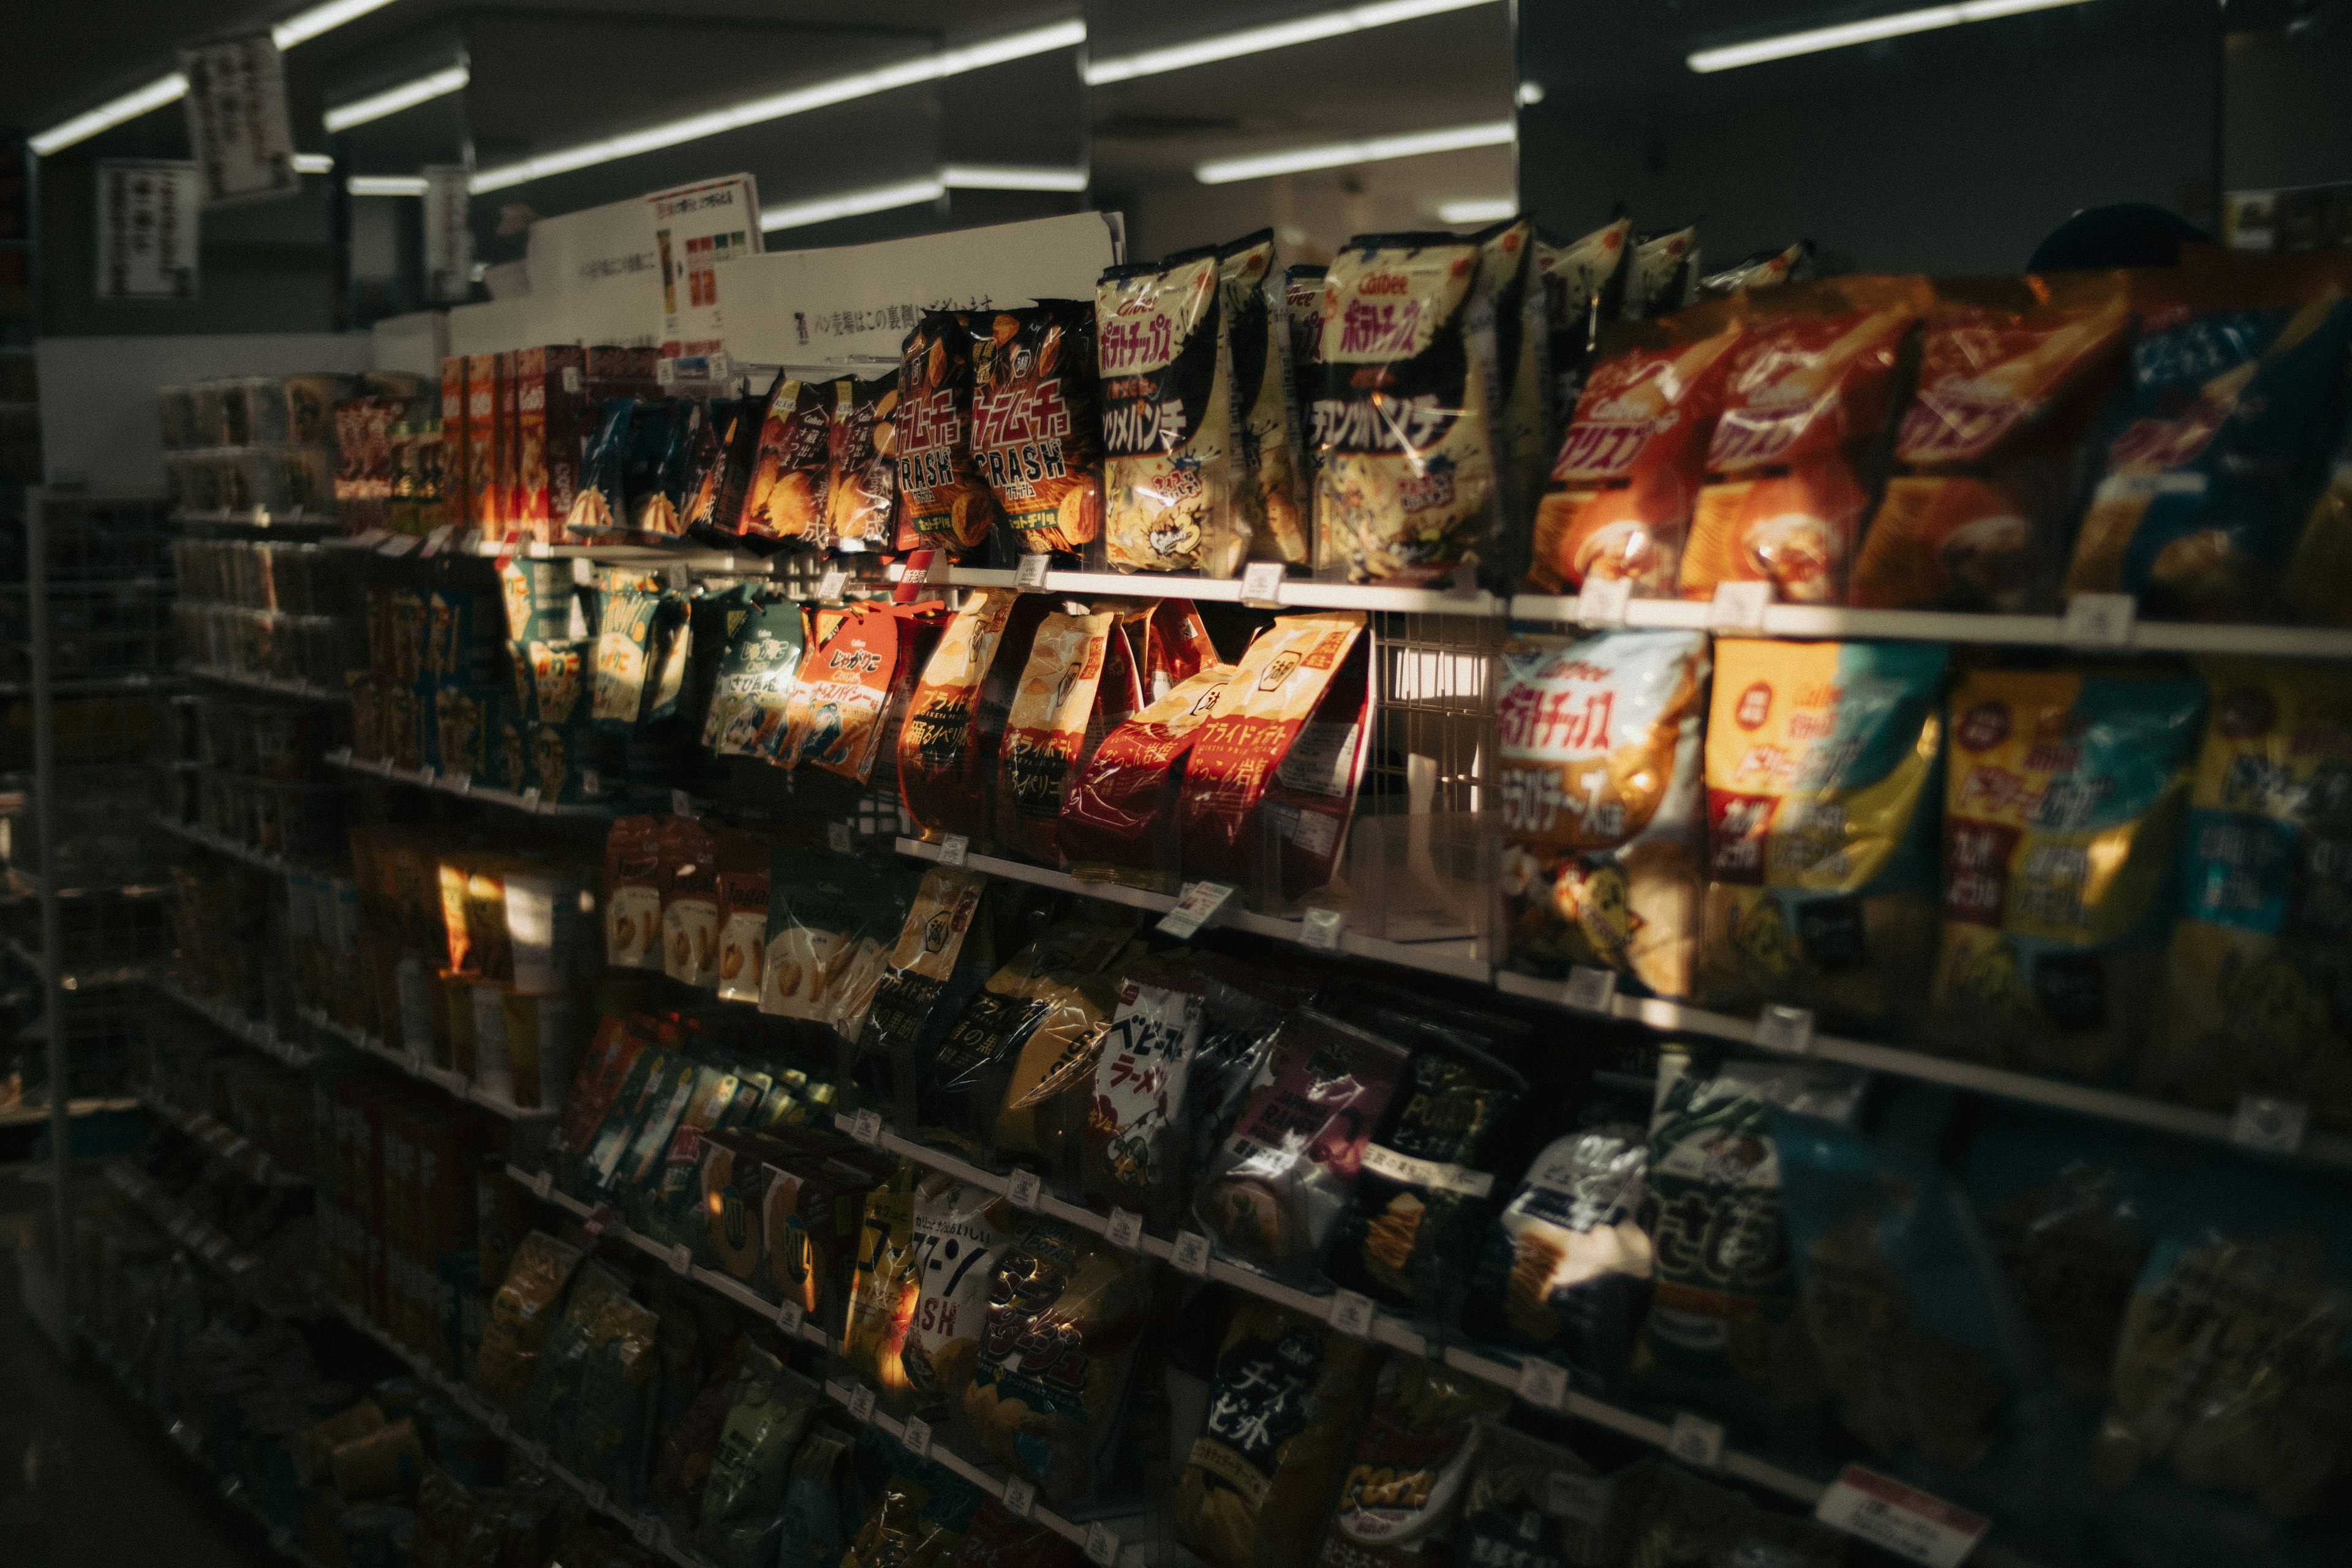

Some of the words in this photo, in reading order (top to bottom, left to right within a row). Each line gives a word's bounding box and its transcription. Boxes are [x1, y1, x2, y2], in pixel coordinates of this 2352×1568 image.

[1101, 314, 1172, 371] ポテトチップス
[897, 446, 955, 492] RASH
[903, 569, 927, 584] 新発売
[829, 649, 882, 673] じゃがりこ
[1203, 723, 1287, 745] プライドポテト
